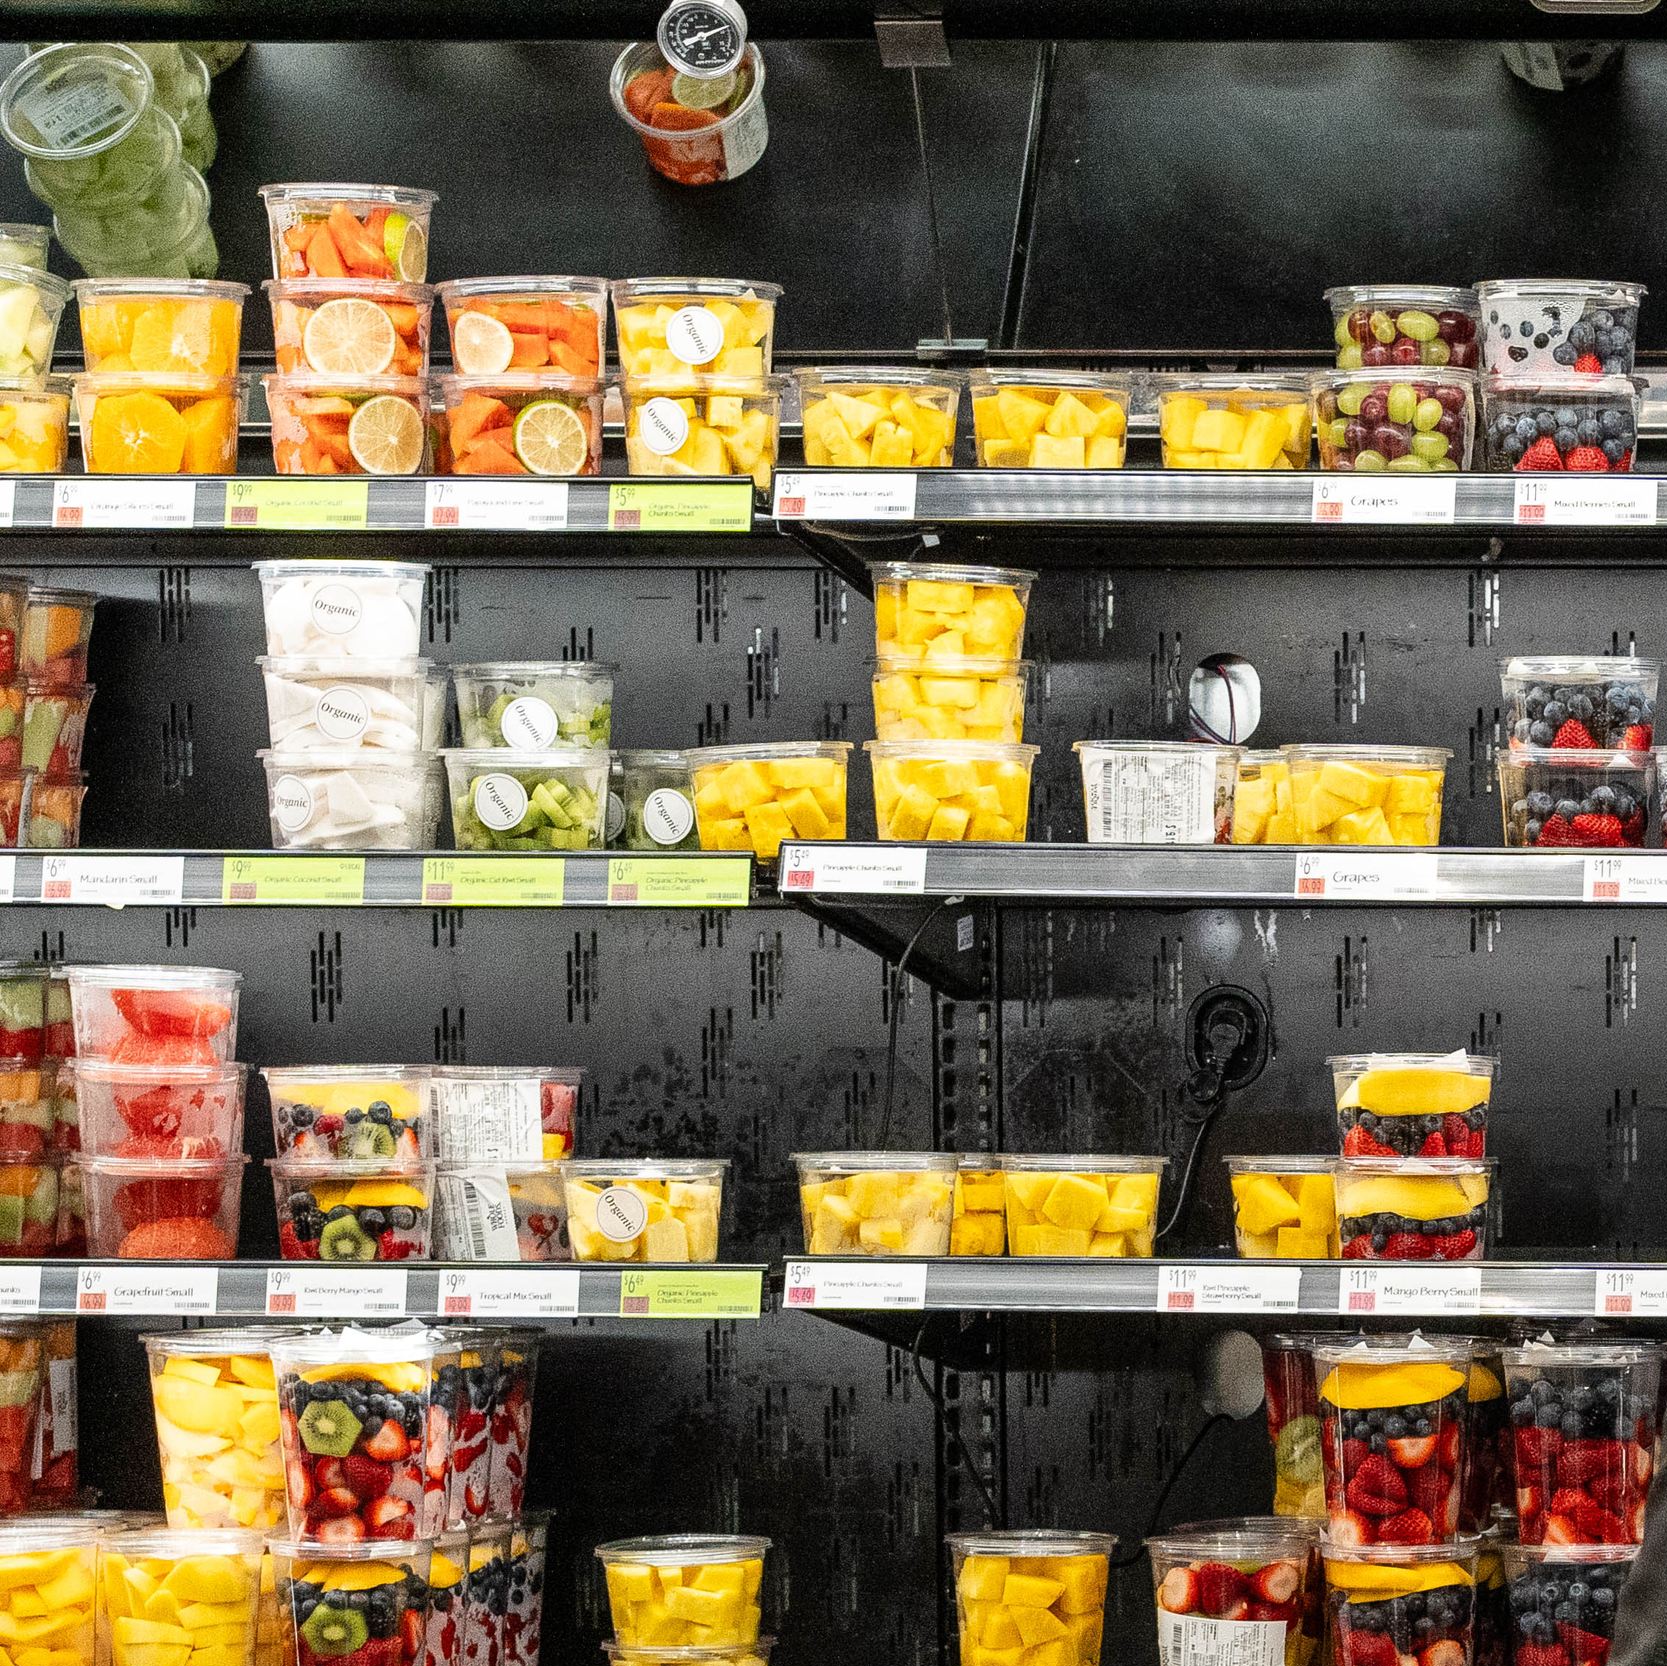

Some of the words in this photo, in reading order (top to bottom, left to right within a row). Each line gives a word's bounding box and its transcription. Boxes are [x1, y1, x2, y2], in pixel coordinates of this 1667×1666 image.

[683, 314, 707, 355] Organic
[648, 408, 677, 442] Organic
[1351, 496, 1399, 507] Grapes
[315, 599, 359, 617] Organic
[321, 702, 364, 724] Organic
[485, 782, 514, 820] Organic
[654, 797, 679, 835] Organic
[80, 874, 127, 884] Mandarin
[129, 874, 157, 883] Small
[1333, 871, 1380, 884] Grapes
[605, 1195, 635, 1232] Organic
[114, 1286, 164, 1298] Grapefruit
[166, 1286, 193, 1297] Small
[1384, 1286, 1417, 1297] Mango
[1420, 1286, 1448, 1298] Berry
[1450, 1286, 1478, 1296] Small
